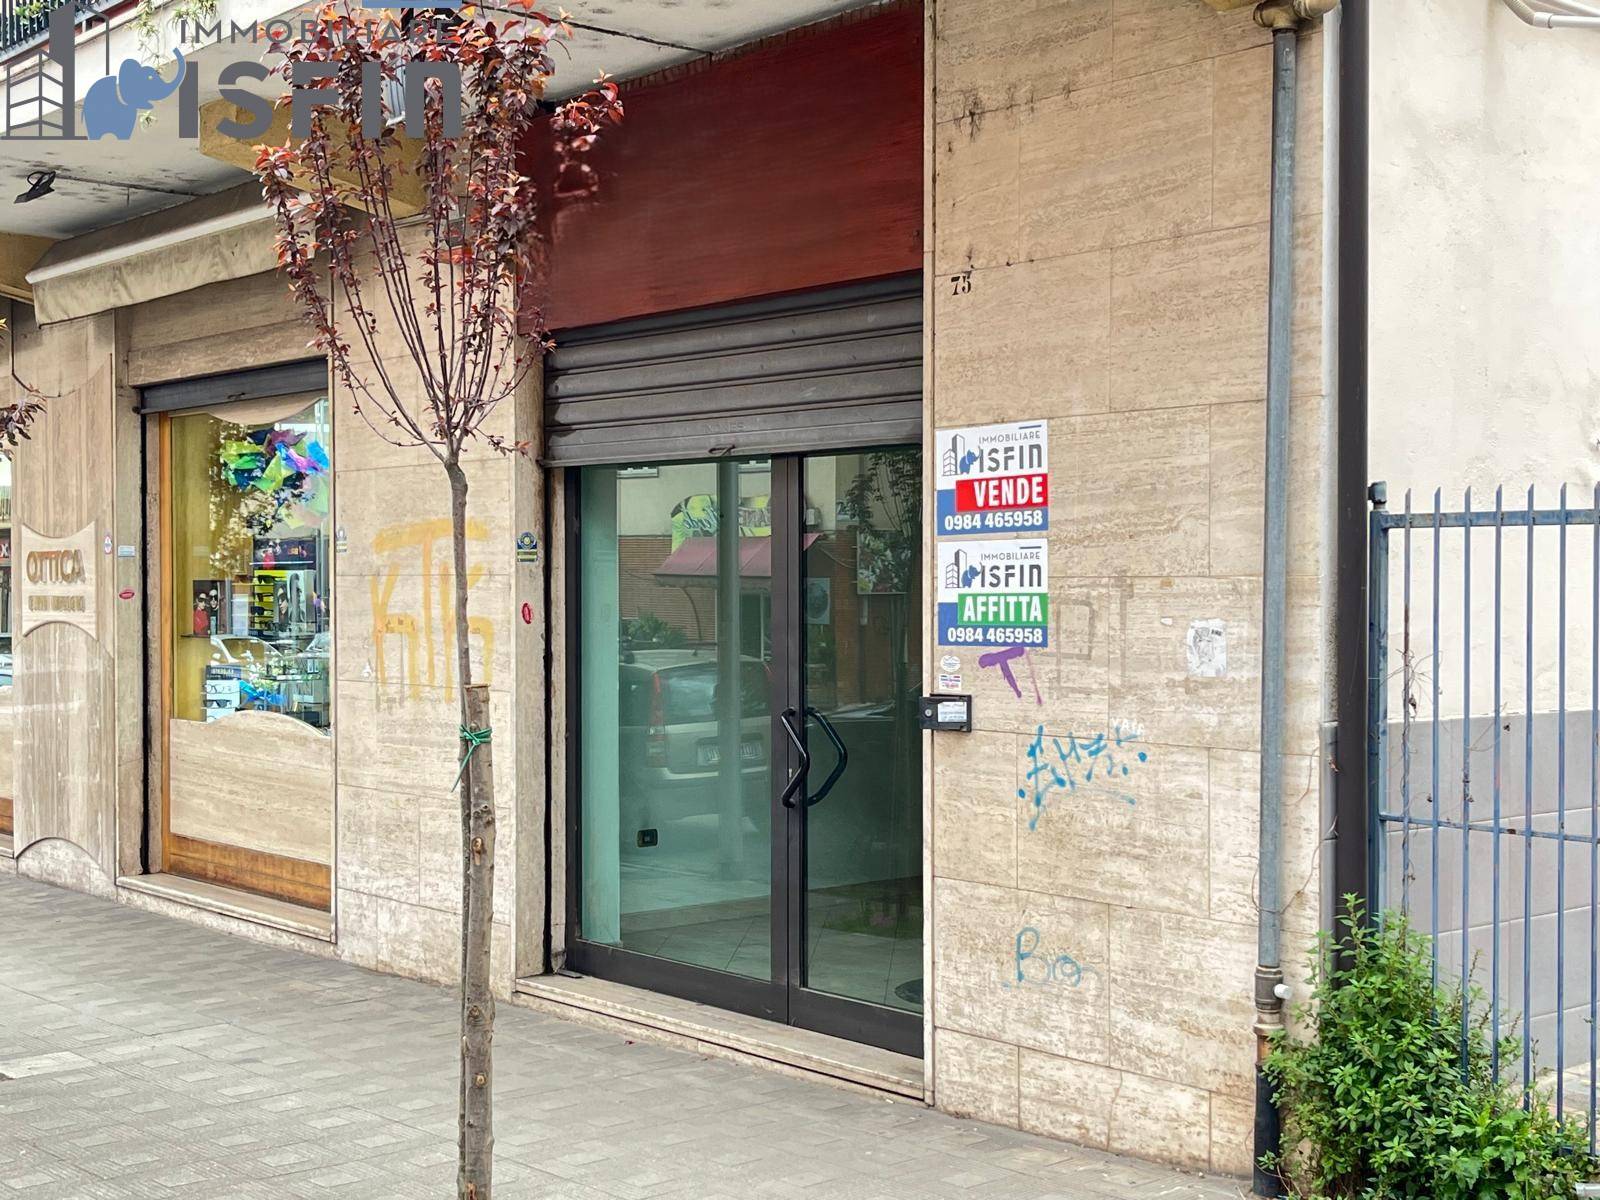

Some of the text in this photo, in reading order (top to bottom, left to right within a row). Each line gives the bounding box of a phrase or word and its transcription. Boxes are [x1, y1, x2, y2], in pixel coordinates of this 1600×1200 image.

[978, 431, 1041, 445] IMMOBILIARE
[979, 444, 1042, 473] ISFIN
[973, 476, 1044, 508] VENDE
[944, 509, 1043, 531] 0984 465958
[26, 549, 86, 584] OTTICA
[980, 551, 1041, 561] IMMOBILIARE
[980, 564, 1042, 588] ISFIN
[963, 595, 1043, 622] AFFITTA
[947, 626, 1043, 643] 0984 465958
